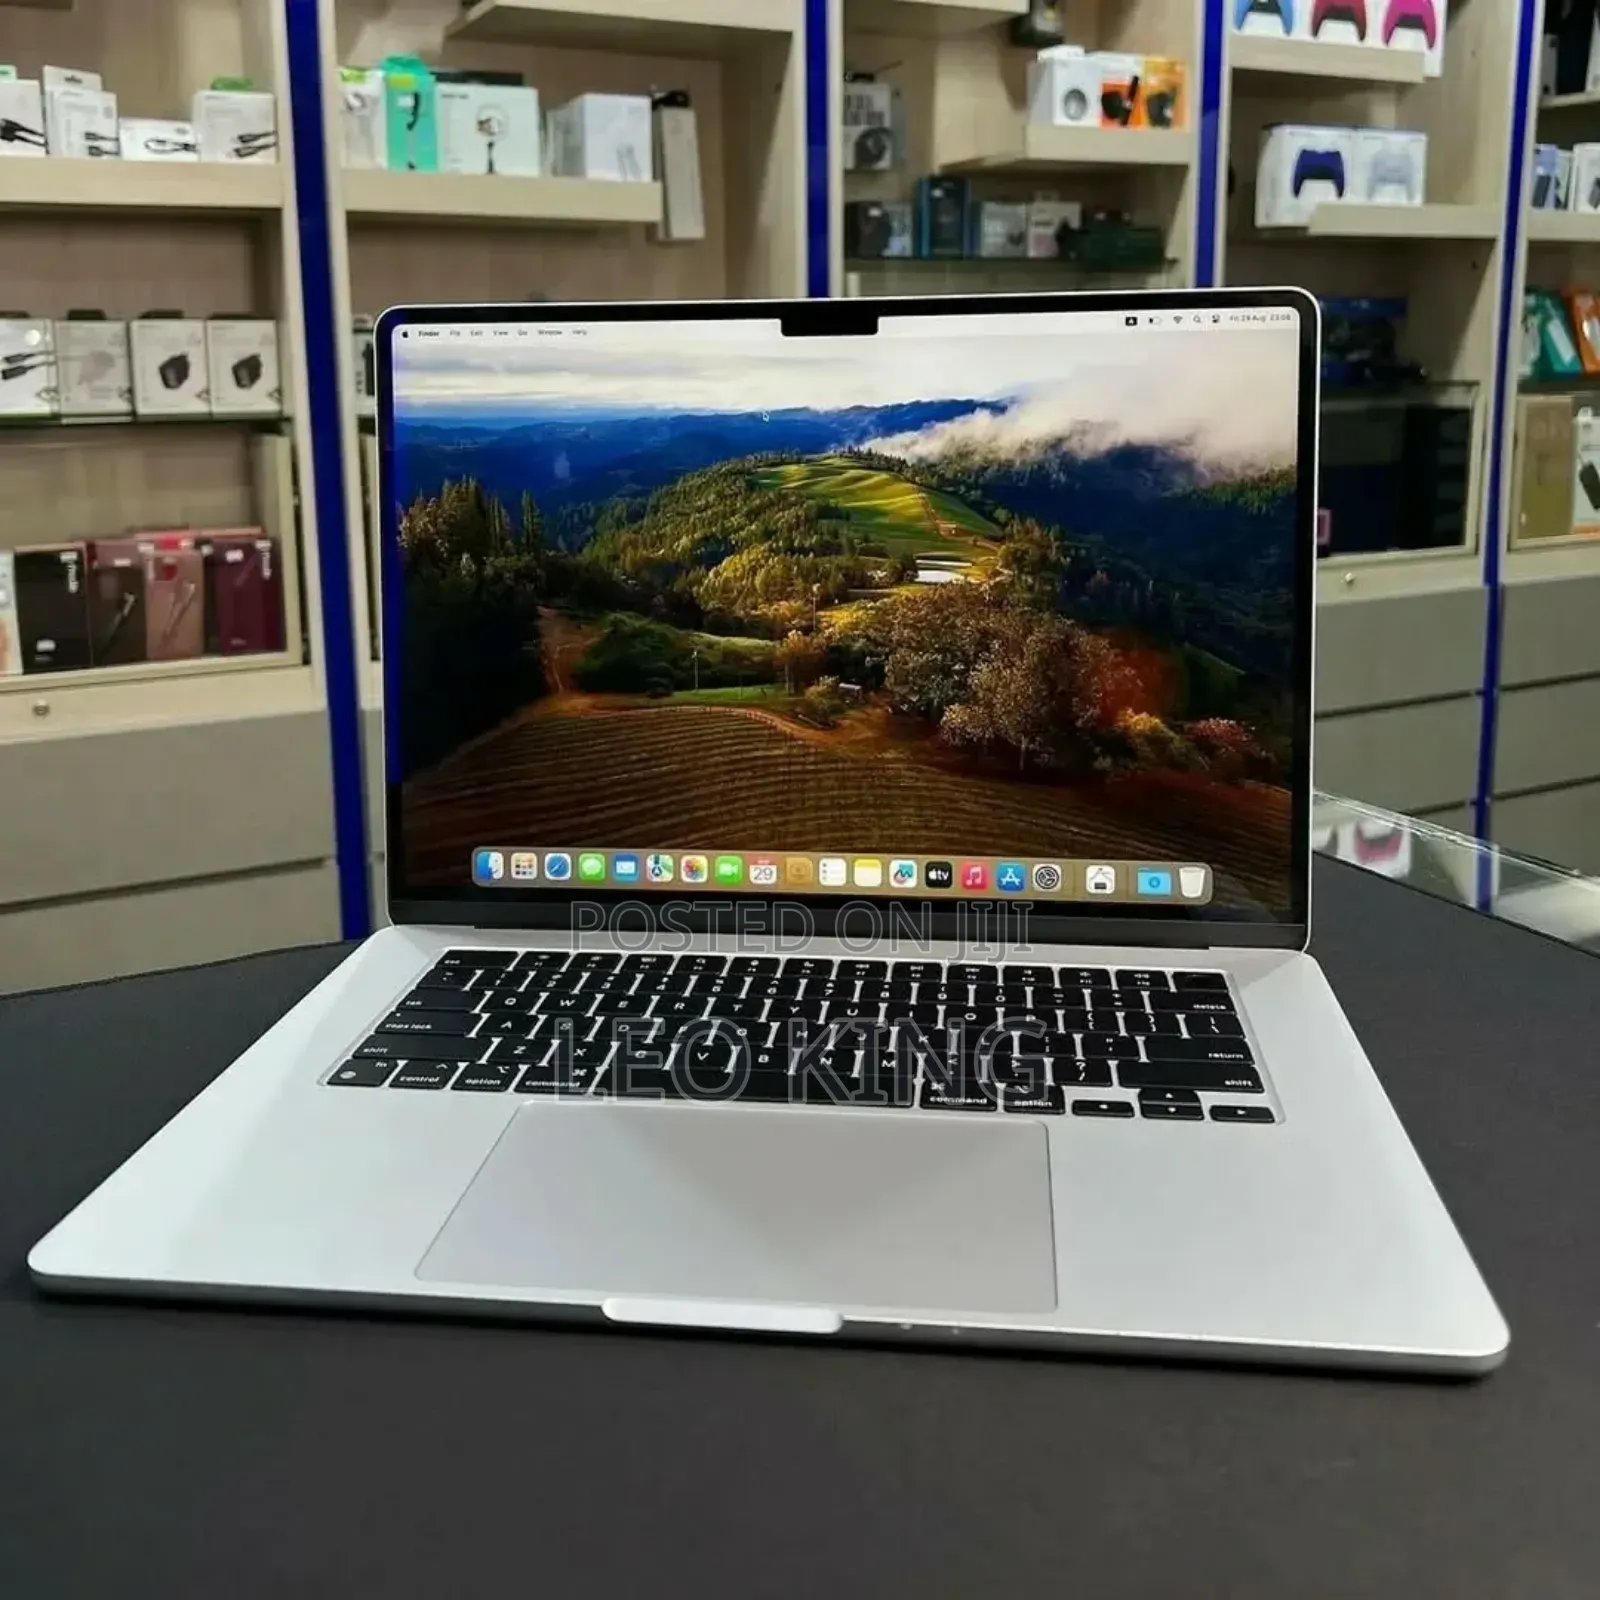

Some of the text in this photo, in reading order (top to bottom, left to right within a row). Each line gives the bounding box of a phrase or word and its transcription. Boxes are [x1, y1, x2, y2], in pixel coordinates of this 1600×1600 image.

[753, 867, 774, 881] 29
[559, 999, 576, 1007] W
[674, 1002, 686, 1010] R
[732, 1003, 743, 1012] T
[789, 1006, 800, 1014] Y
[846, 1008, 859, 1016] U
[617, 1024, 630, 1032] D
[796, 1030, 808, 1038] H
[573, 1048, 587, 1056] X
[697, 1052, 710, 1060] V
[758, 1054, 770, 1063] B
[819, 1057, 833, 1065] N
[881, 1059, 896, 1068] M
[400, 1075, 440, 1083] control
[465, 1078, 501, 1086] option
[1224, 1079, 1253, 1087] shift
[525, 1080, 581, 1088] command
[930, 1096, 987, 1104] command
[1014, 1100, 1052, 1108] option
